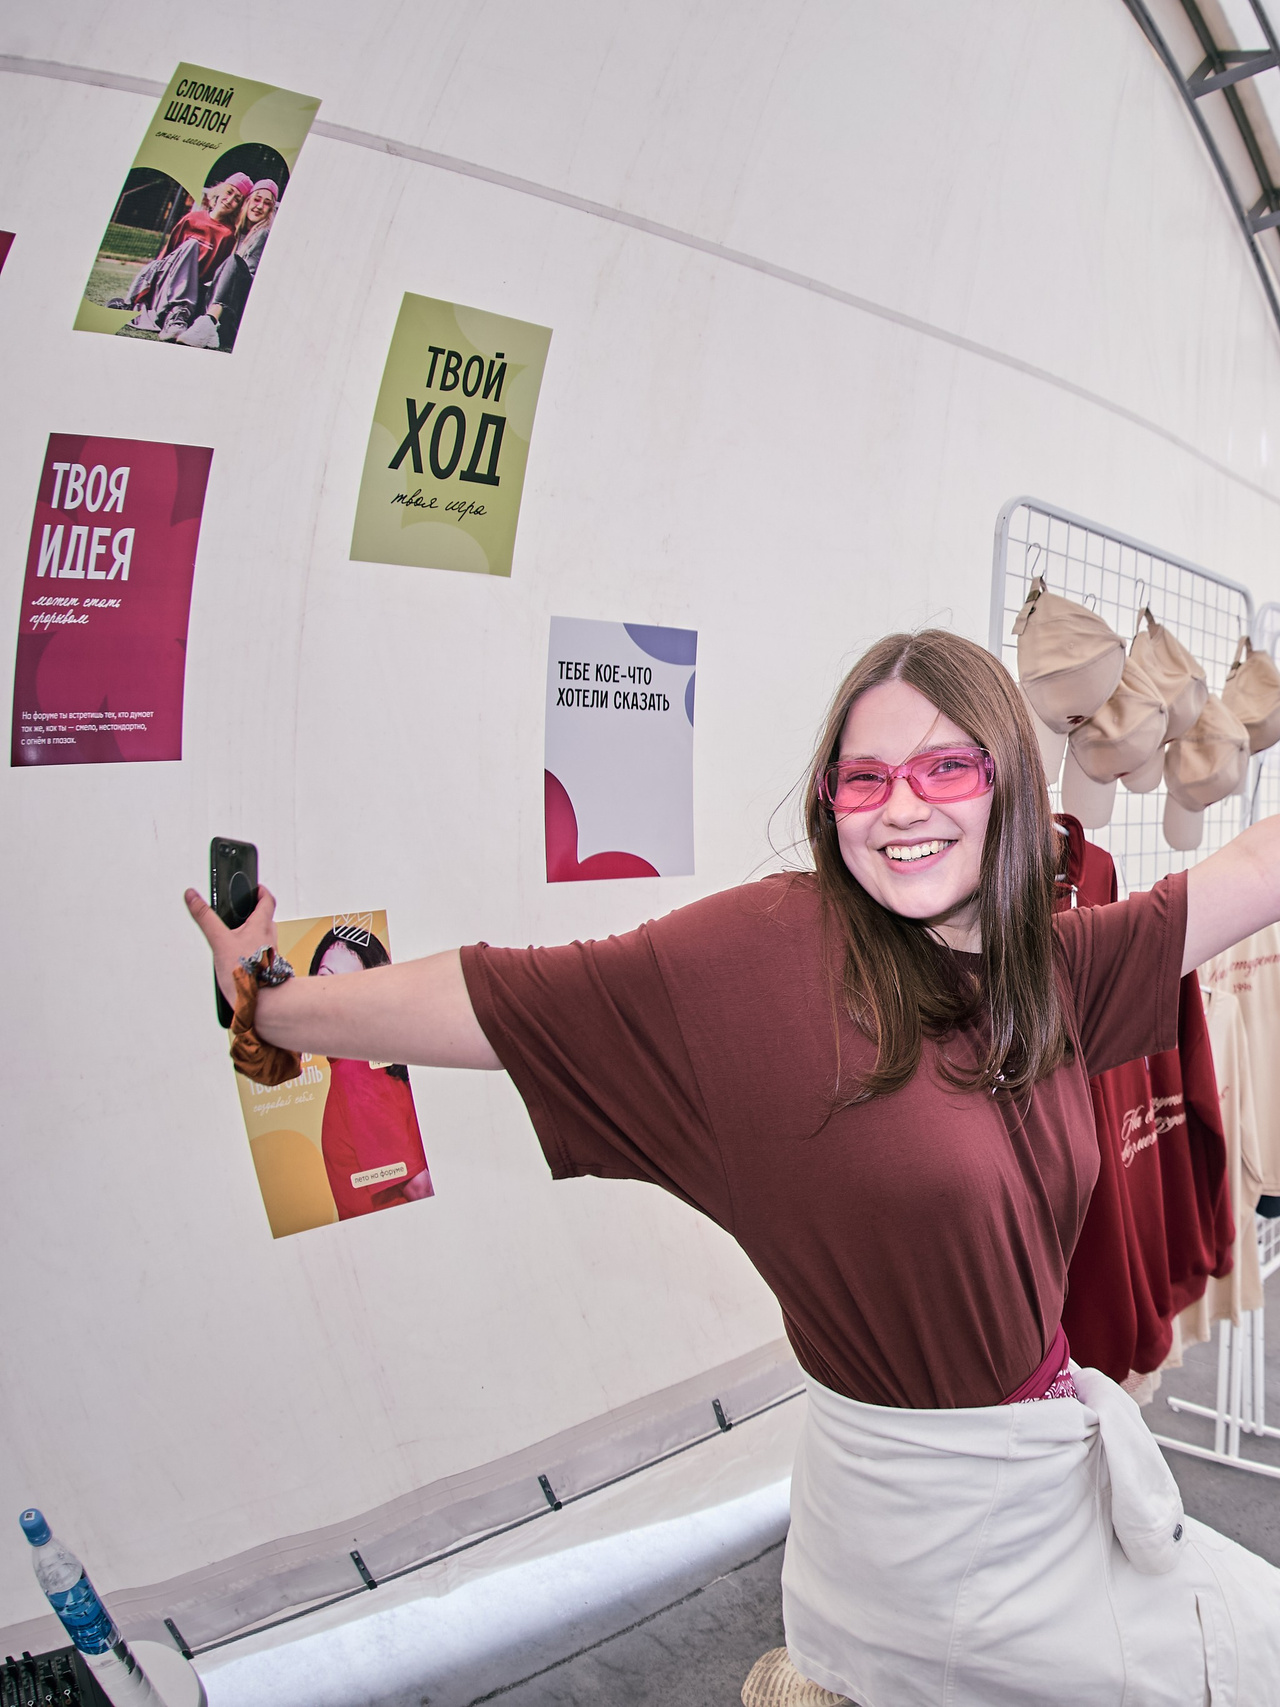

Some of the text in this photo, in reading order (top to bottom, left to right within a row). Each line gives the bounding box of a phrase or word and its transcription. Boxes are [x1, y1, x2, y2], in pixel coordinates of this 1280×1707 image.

[176, 79, 234, 108] СЛОМАЙ
[164, 101, 232, 134] ШАБЛОН
[426, 345, 508, 403] ТВОЙ
[388, 397, 507, 487] ХОД
[51, 462, 130, 513] ТВОЯ
[391, 488, 488, 522] твоя игра
[37, 524, 136, 581] ИДЕЯ
[32, 595, 122, 608] может стать
[29, 609, 89, 631] прорывом
[558, 661, 652, 685] ТЕБЕ КОЕ-ЧТО
[556, 687, 670, 711] ХОТЕЛИ СКАЗАТЬ
[22, 712, 33, 720] На
[33, 711, 58, 721] форуме
[69, 711, 104, 720] встретишь
[105, 711, 117, 719] тех,
[130, 710, 154, 719] думает
[75, 724, 98, 732] смело,
[99, 723, 147, 732] нестандартно,
[26, 736, 46, 745] огнём
[354, 1175, 369, 1184] лето
[380, 1166, 404, 1178] форуме
